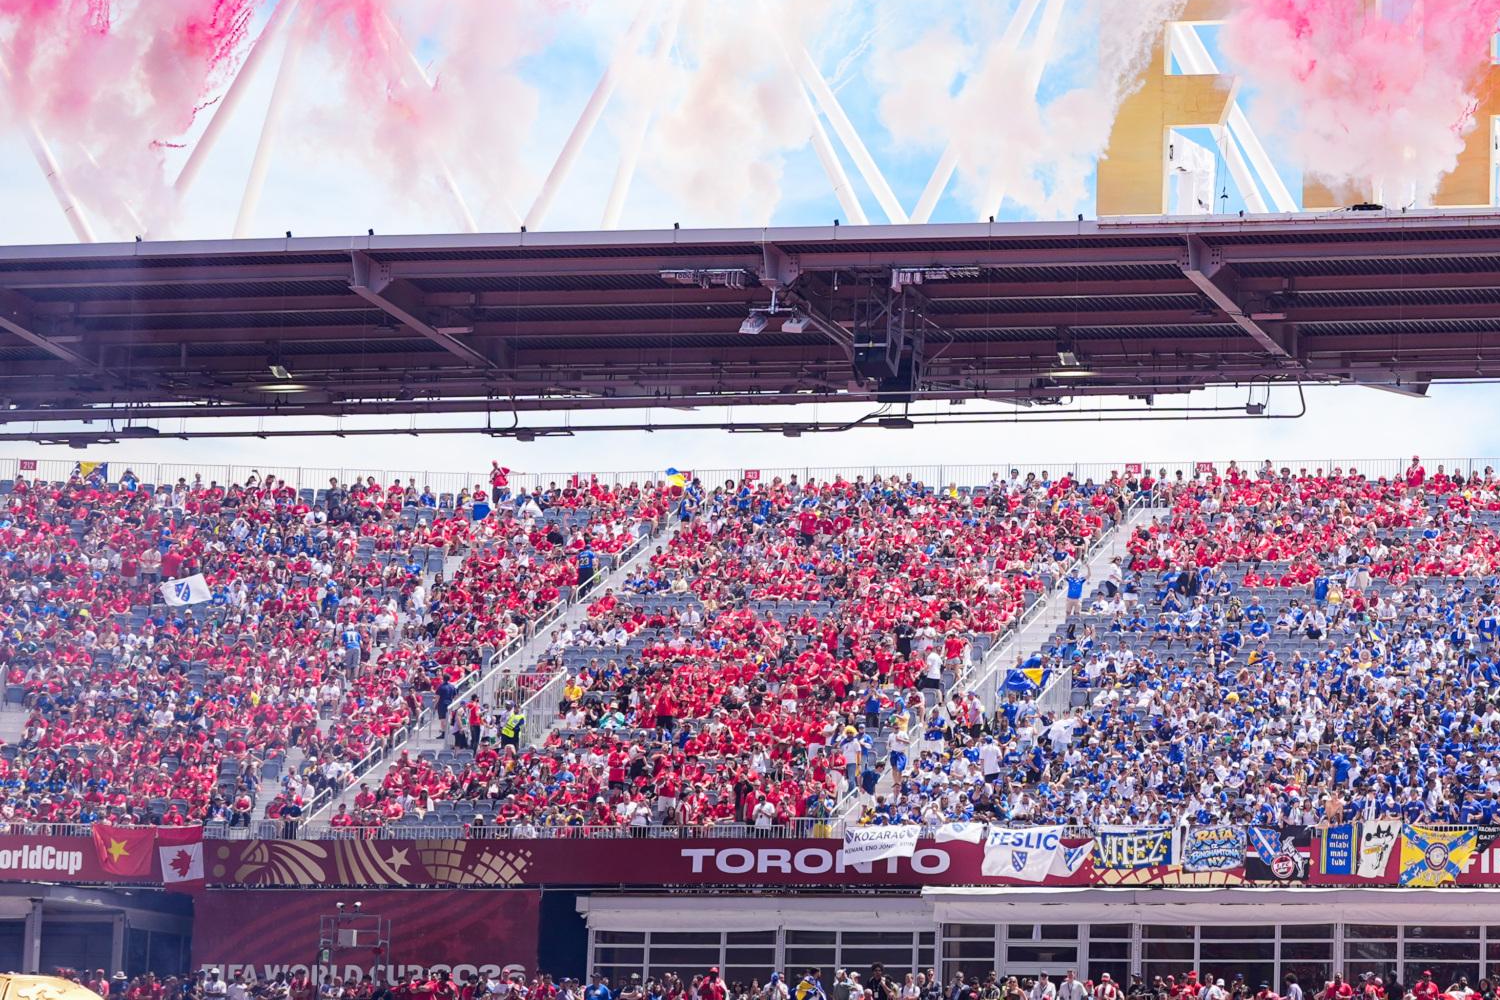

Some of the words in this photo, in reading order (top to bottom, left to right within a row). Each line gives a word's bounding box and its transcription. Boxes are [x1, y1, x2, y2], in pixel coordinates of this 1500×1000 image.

[580, 557, 589, 566] 23
[990, 830, 1059, 851] TESLIĆ
[1095, 832, 1164, 865] VITEZ
